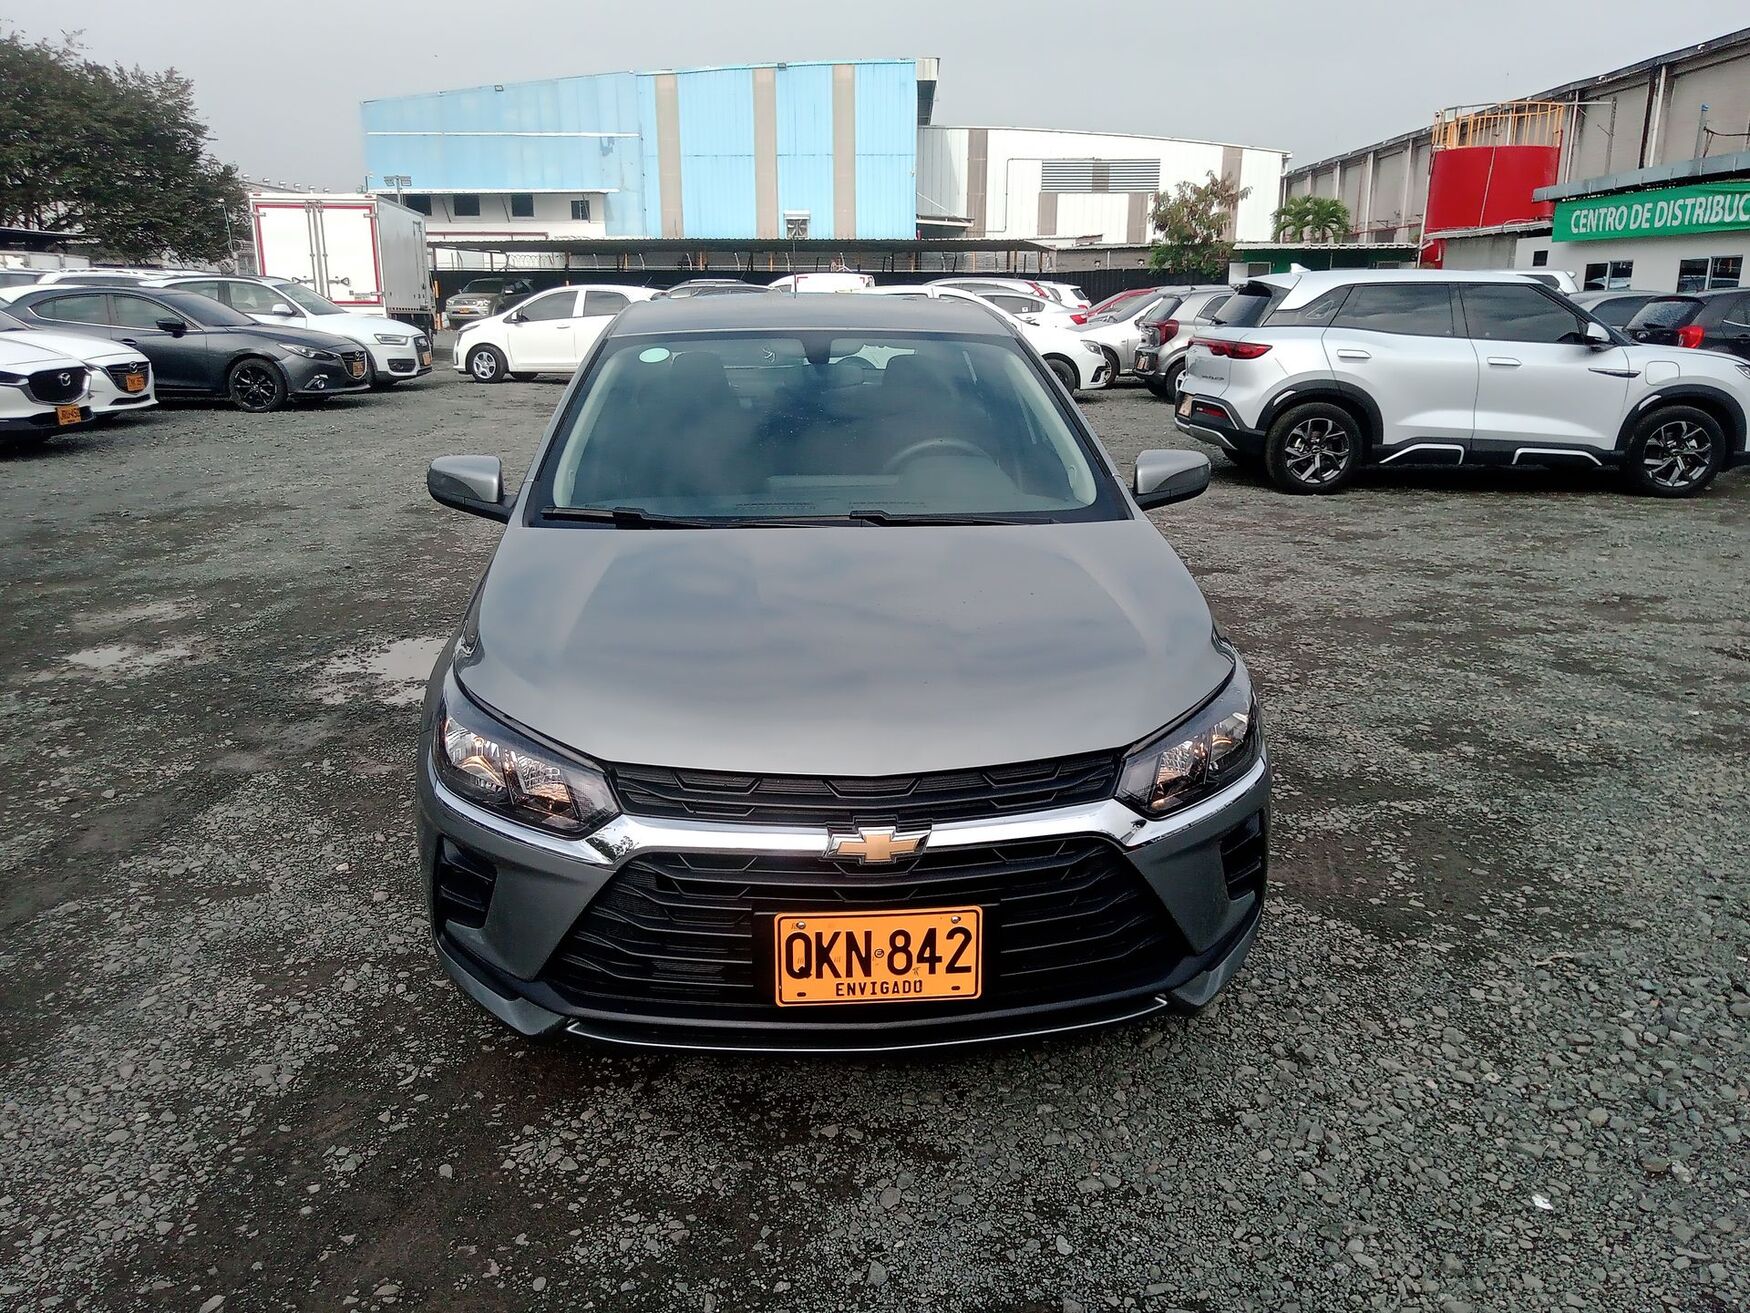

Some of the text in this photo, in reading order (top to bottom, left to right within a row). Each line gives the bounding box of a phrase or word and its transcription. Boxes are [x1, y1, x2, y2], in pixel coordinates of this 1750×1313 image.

[1571, 194, 1750, 234] CENTRO DE DISTRIBUC
[836, 980, 923, 998] ENVIGADO
